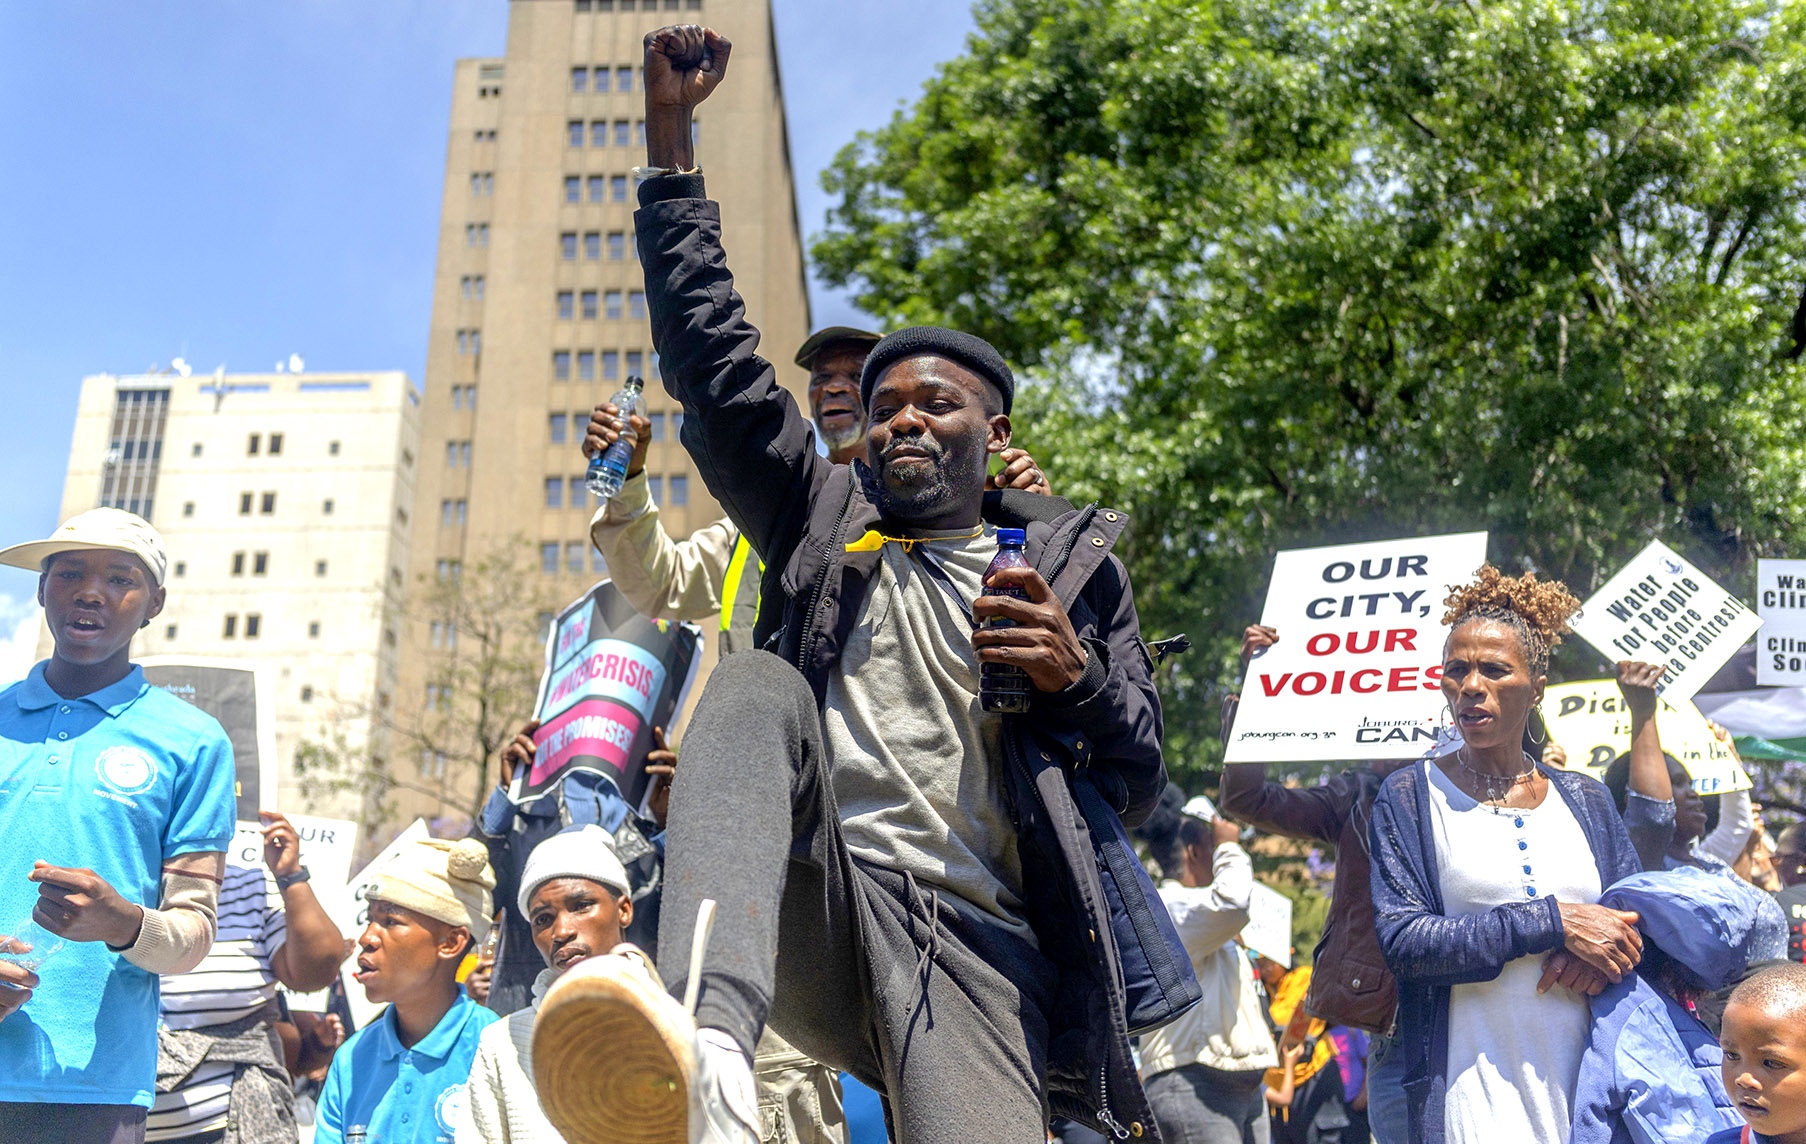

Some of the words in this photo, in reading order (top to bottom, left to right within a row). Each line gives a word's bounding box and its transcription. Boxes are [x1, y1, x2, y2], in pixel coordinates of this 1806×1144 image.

[1322, 554, 1428, 583] OUR
[1305, 589, 1431, 620] CITY,
[1606, 574, 1662, 623] Water
[1613, 626, 1647, 656] for
[1638, 578, 1700, 631] People
[1650, 608, 1702, 654] before
[1306, 628, 1418, 656] OUR
[1259, 665, 1444, 697] VOICES
[1355, 726, 1440, 743] CAN
[299, 827, 335, 844] UR
